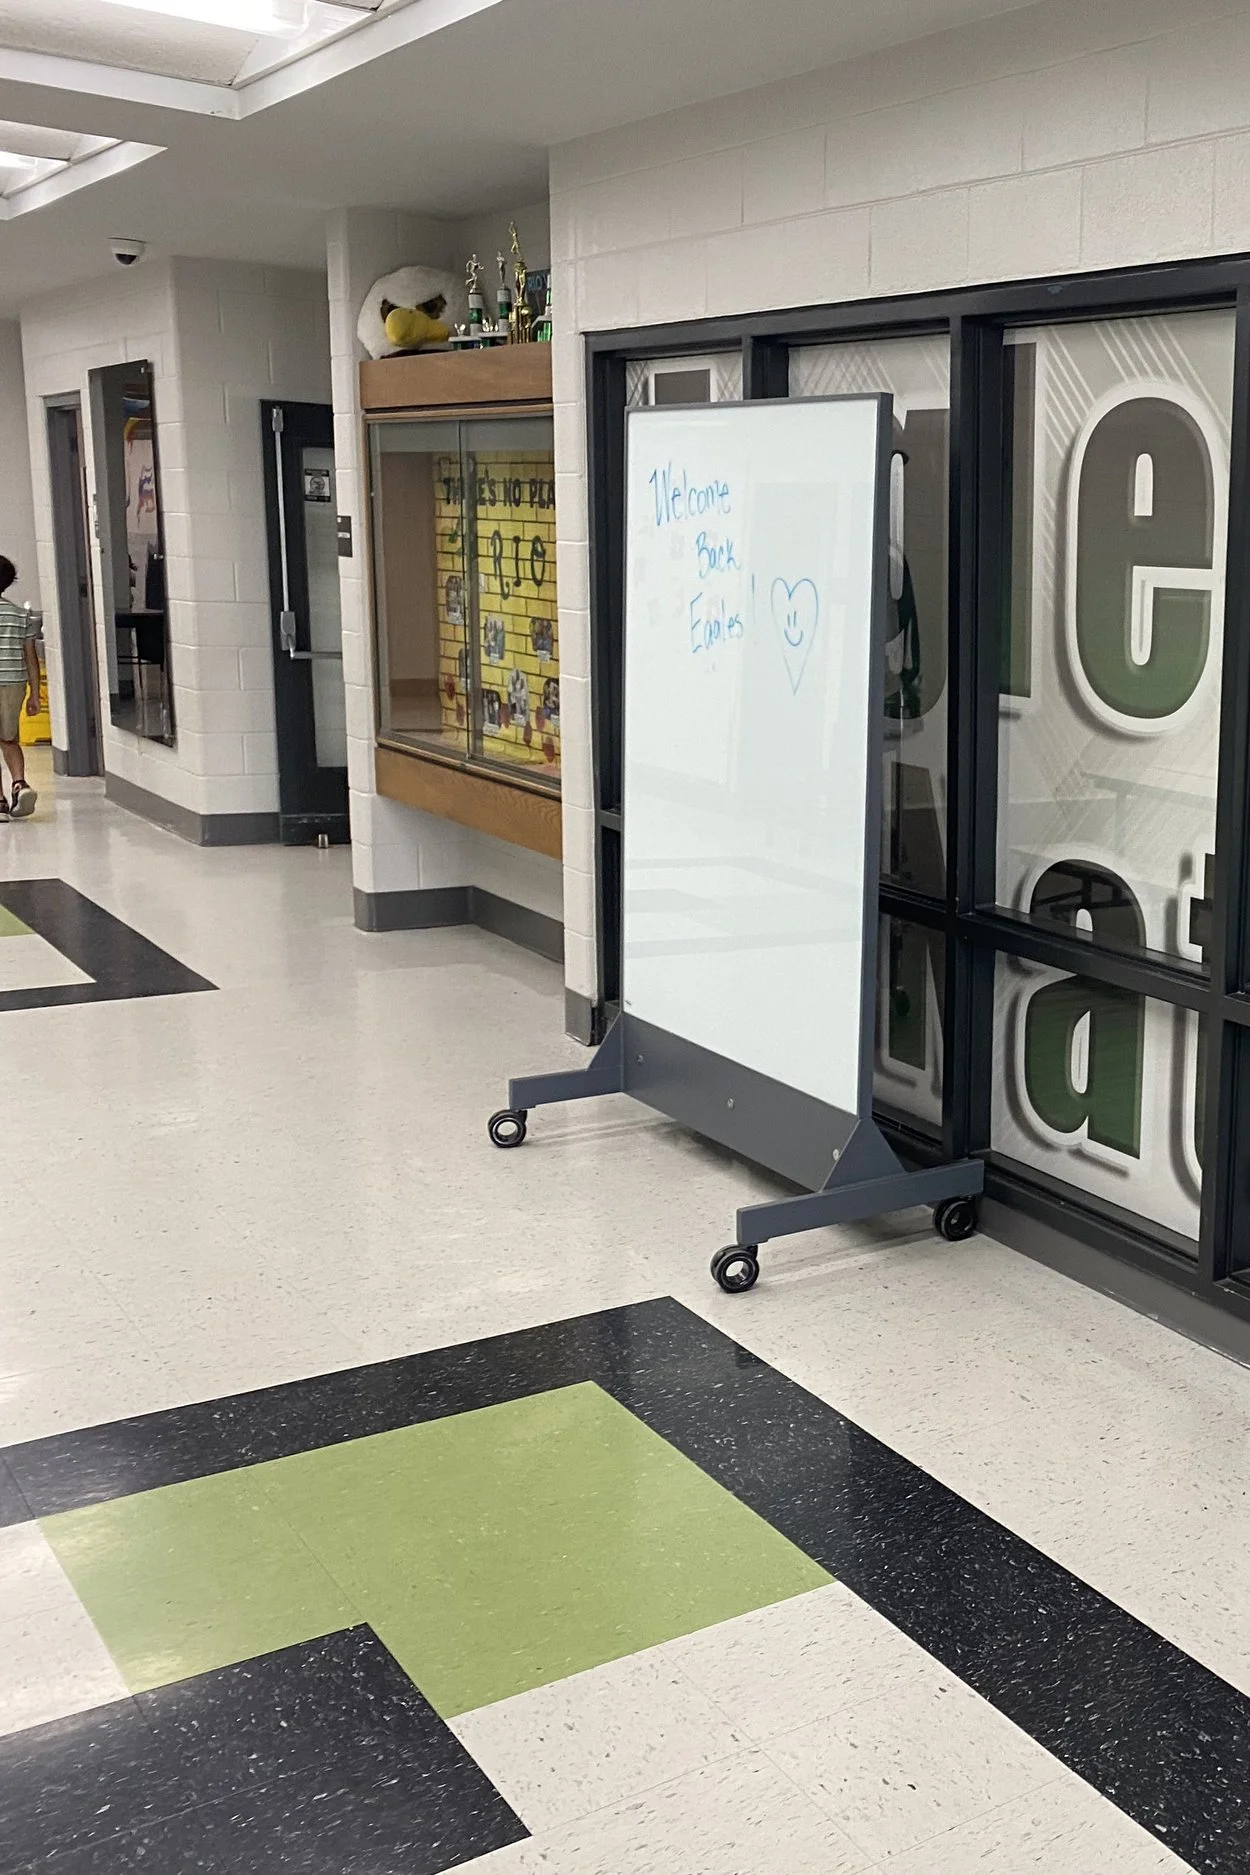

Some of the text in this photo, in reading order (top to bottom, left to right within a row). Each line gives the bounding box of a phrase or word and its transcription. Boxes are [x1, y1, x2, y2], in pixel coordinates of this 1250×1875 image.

[503, 478, 521, 508] NO
[649, 461, 732, 527] Welcome
[490, 530, 546, 600] RIO
[695, 531, 741, 579] Back
